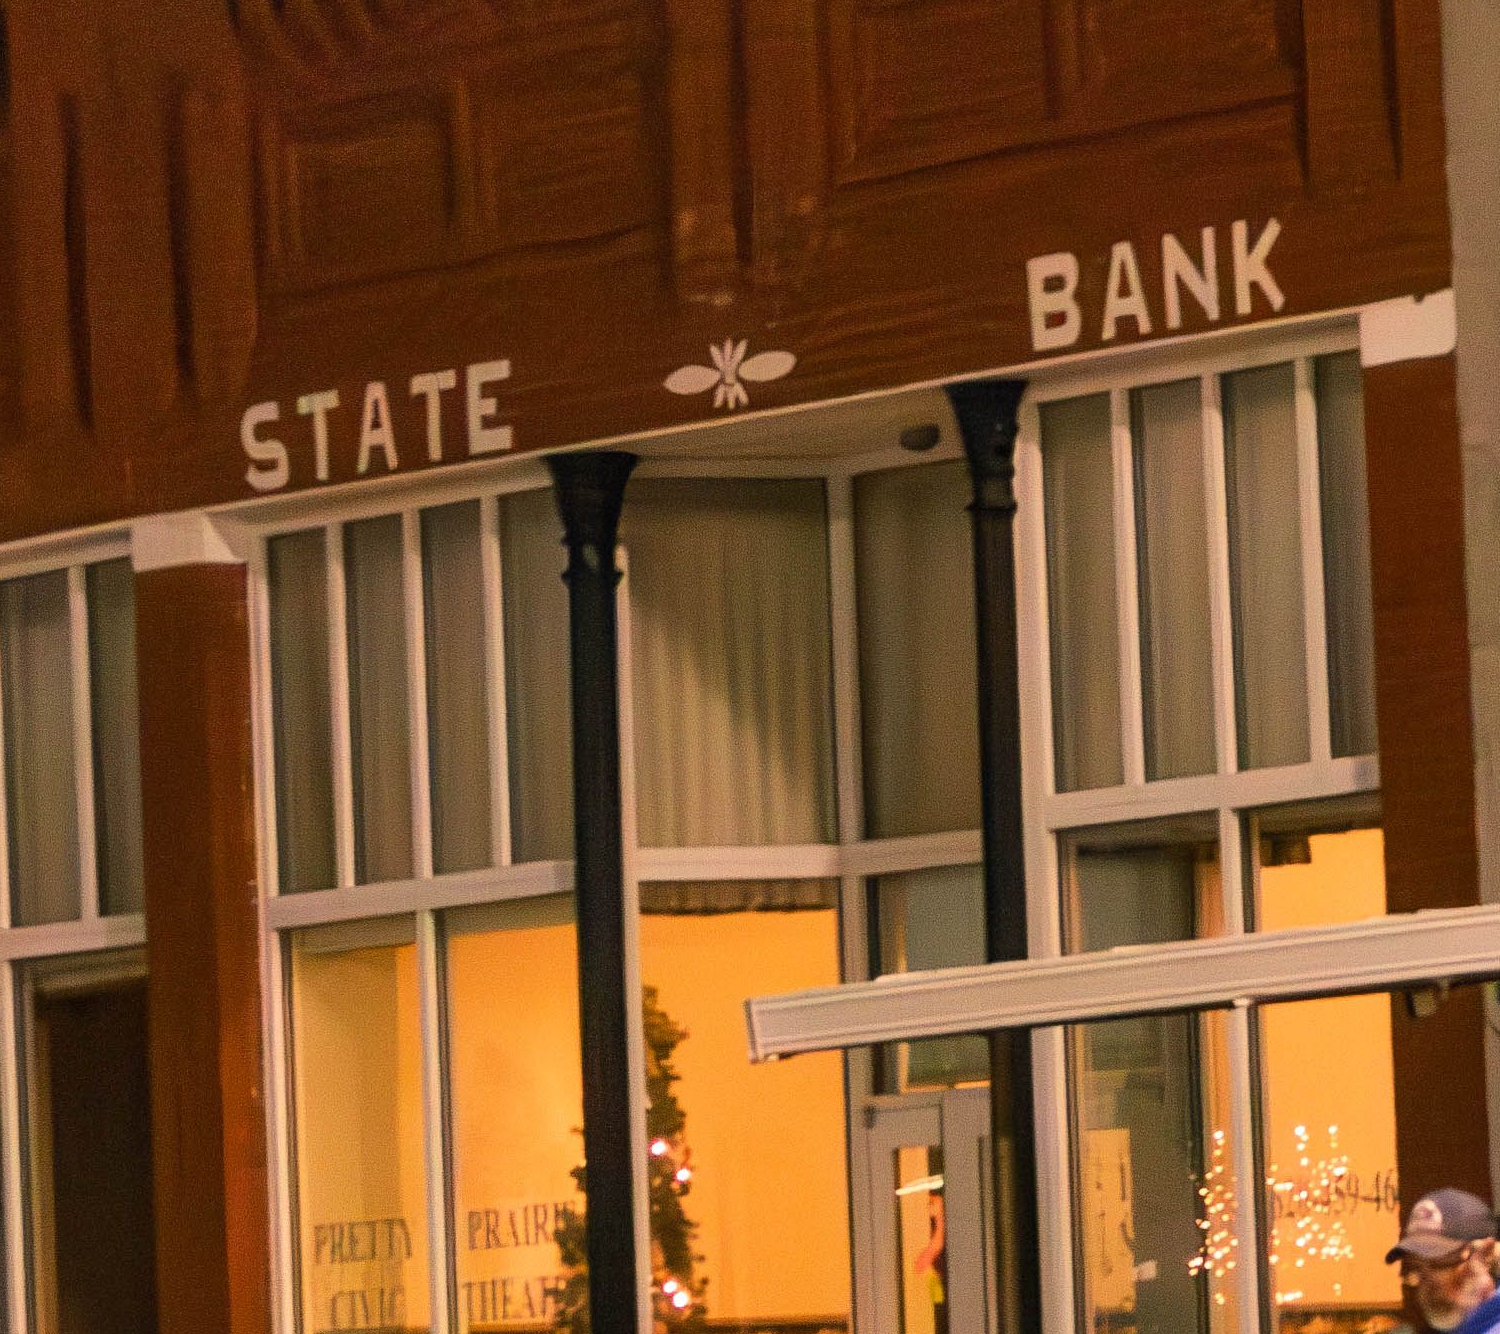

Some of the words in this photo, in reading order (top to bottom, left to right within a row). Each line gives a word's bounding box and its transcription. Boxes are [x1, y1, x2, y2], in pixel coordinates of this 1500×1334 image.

[238, 358, 513, 492] STATE
[1024, 216, 1286, 352] BANK
[313, 1218, 413, 1264] PRETTY
[467, 1200, 574, 1251] PRAIRI
[330, 1285, 406, 1328] CIVIC
